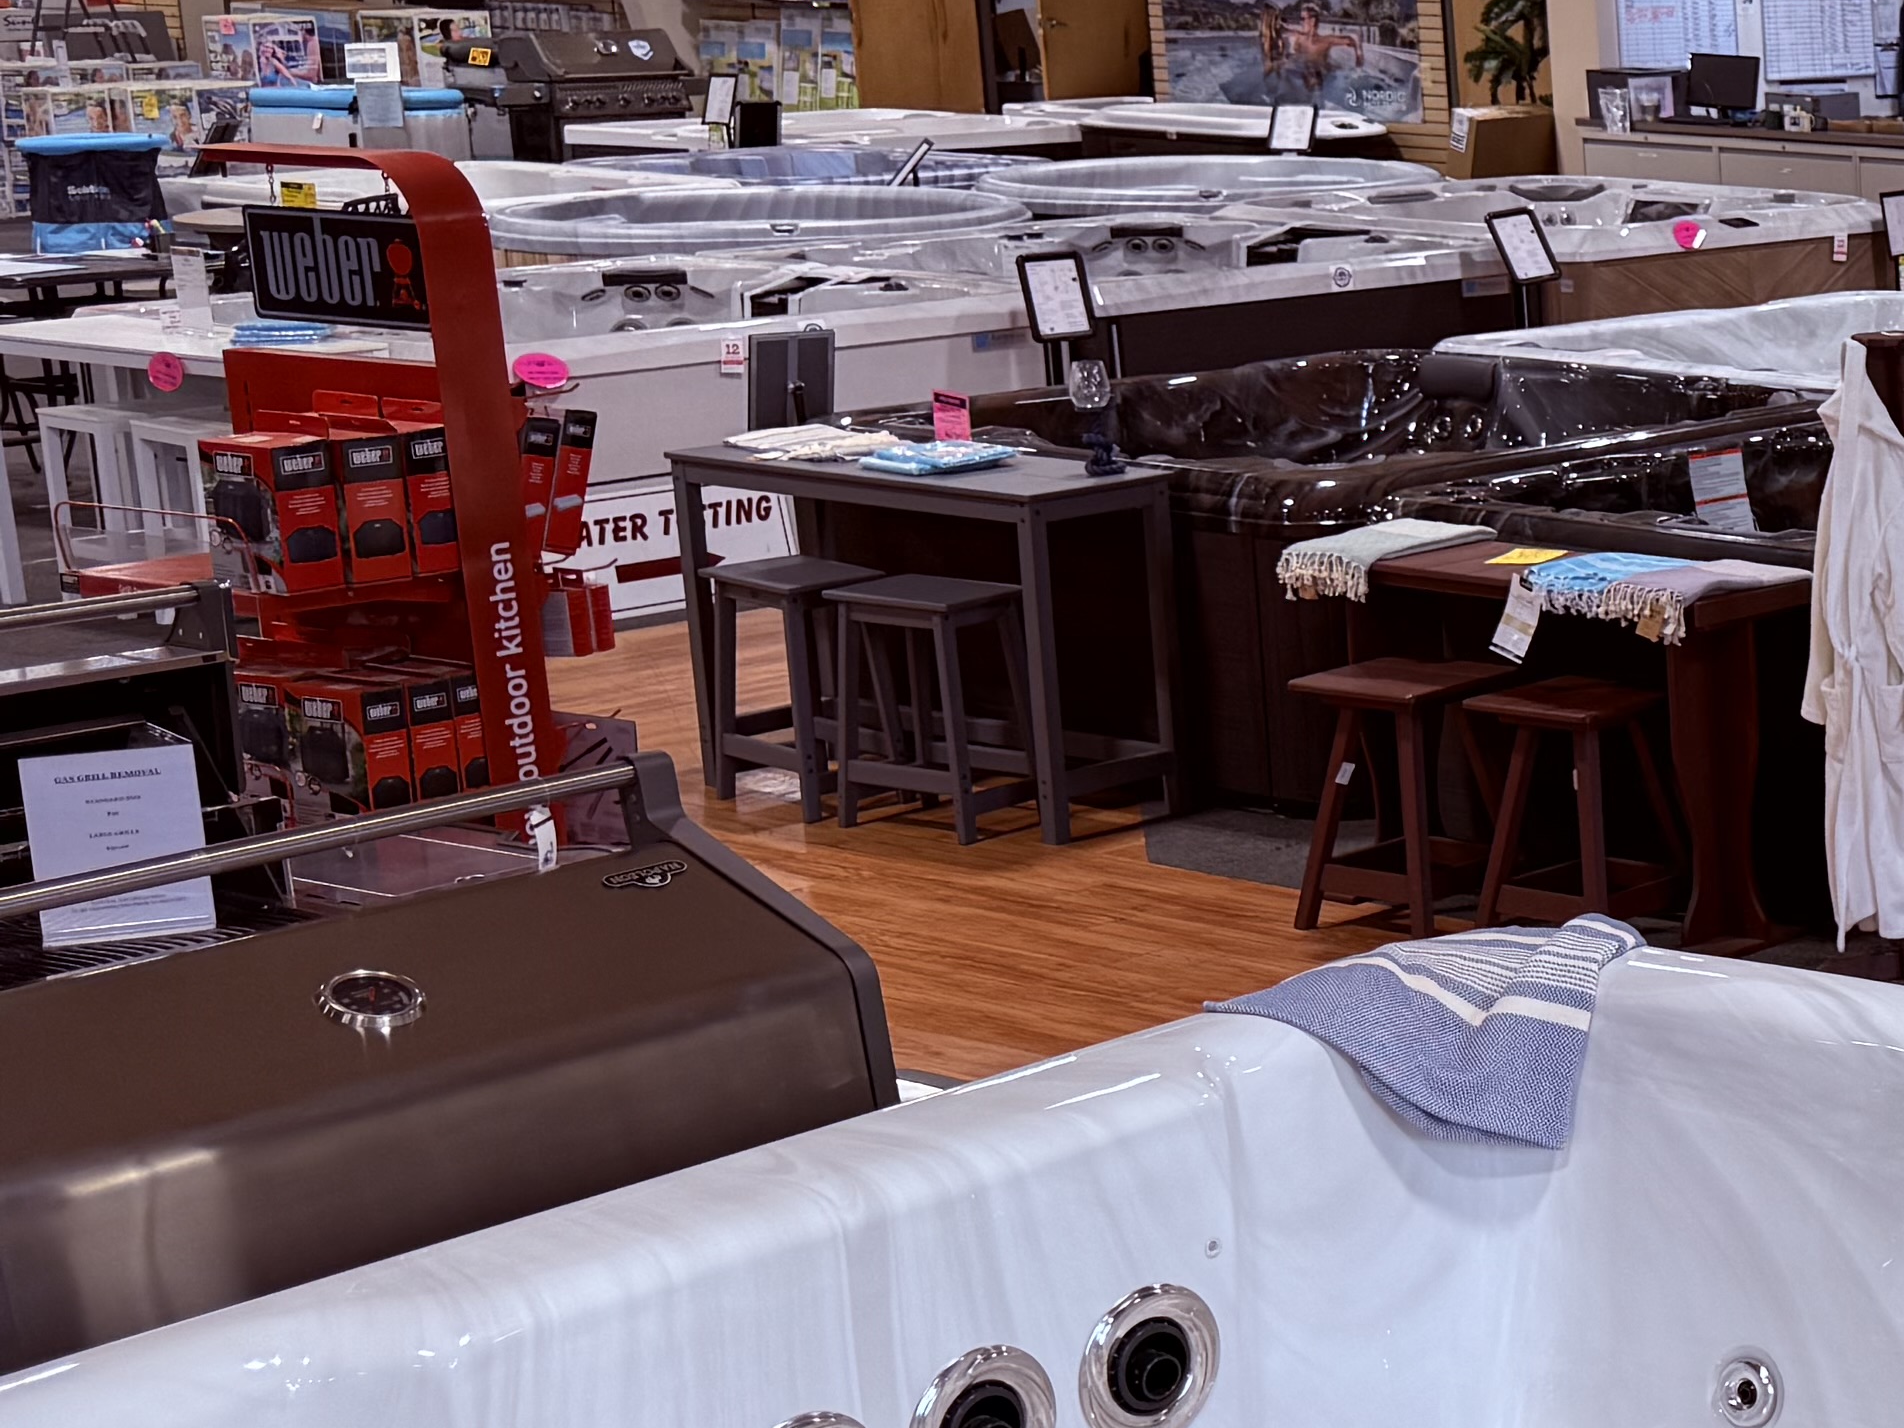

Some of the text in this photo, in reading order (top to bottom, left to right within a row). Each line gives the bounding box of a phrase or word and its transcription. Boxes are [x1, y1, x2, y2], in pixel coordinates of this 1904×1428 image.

[260, 217, 381, 307] weber
[725, 344, 741, 355] 12
[216, 454, 243, 474] weber
[284, 456, 314, 472] weber
[353, 448, 381, 464] weber
[580, 494, 772, 547] ATER TTING
[489, 541, 541, 782] outdoor kitchen
[305, 699, 333, 719] weber
[54, 776, 75, 785] GAS
[110, 767, 162, 779] REMOVAL
